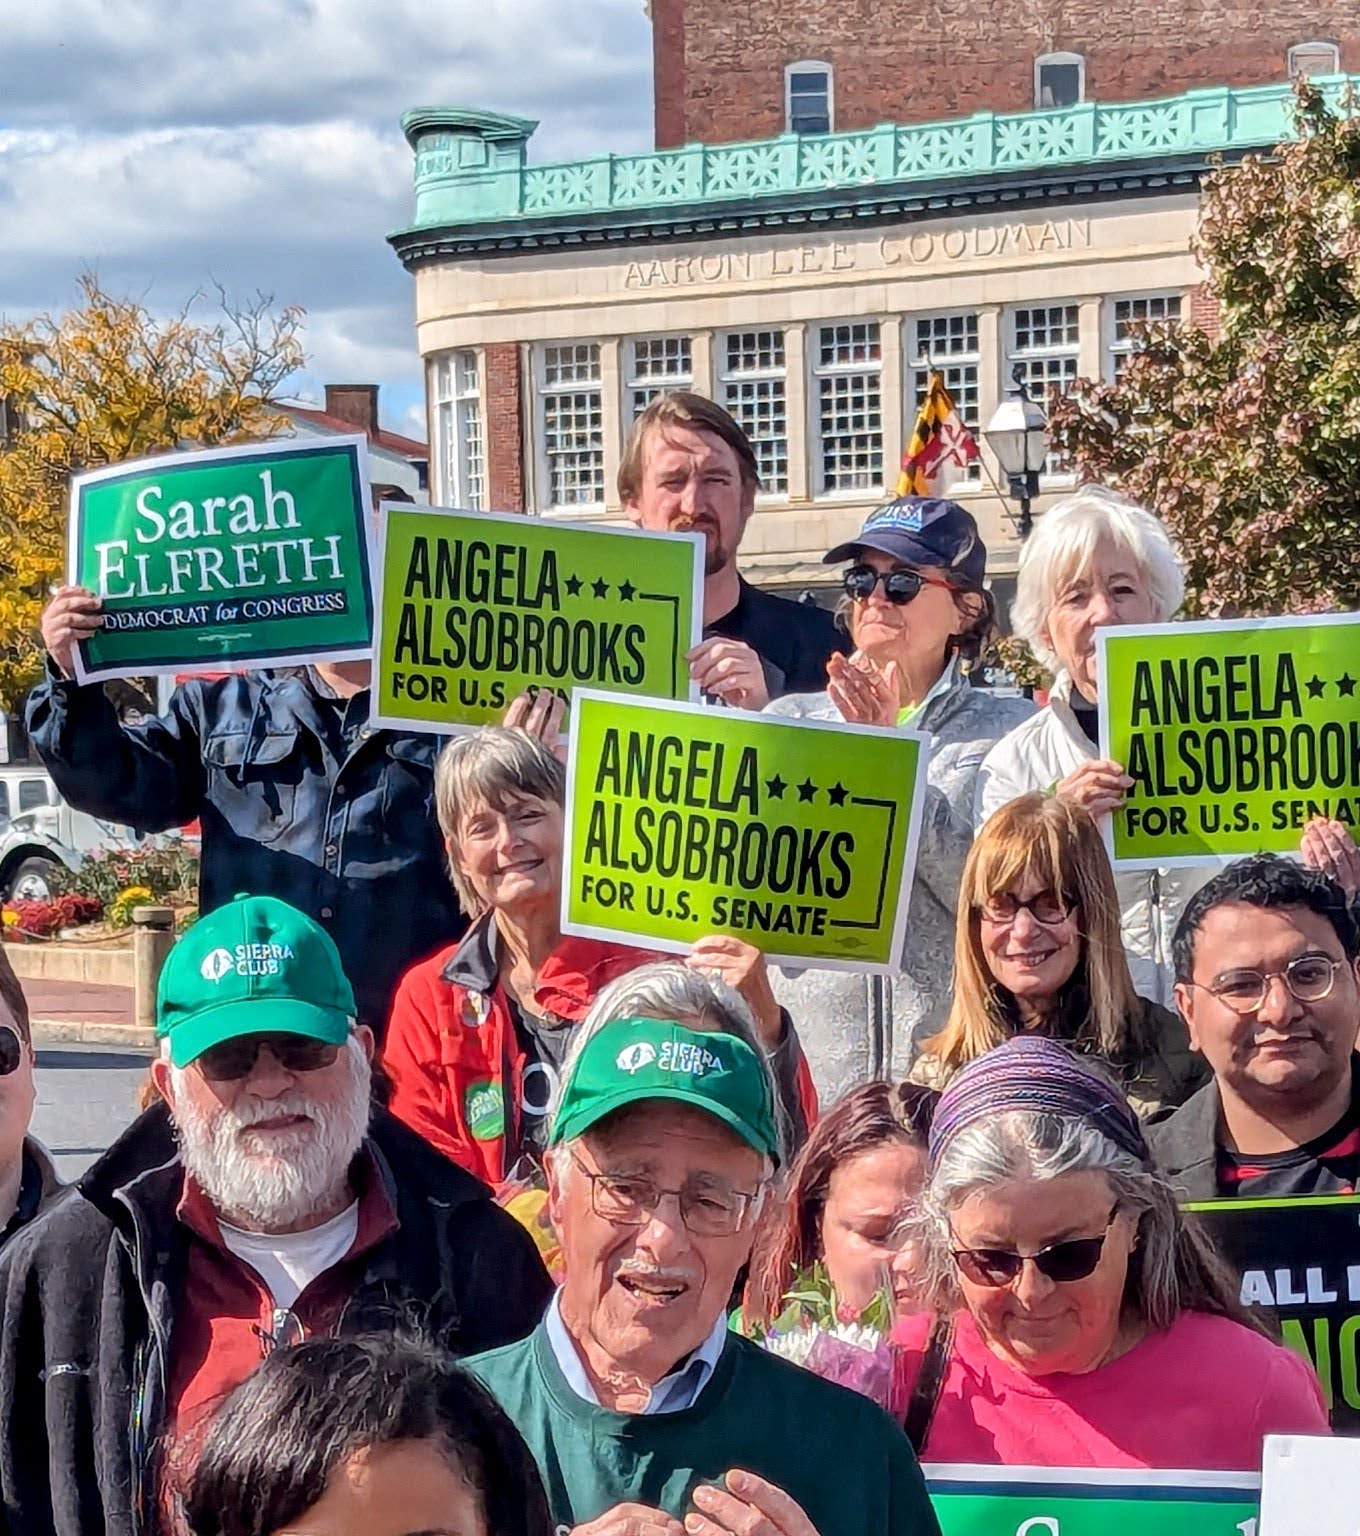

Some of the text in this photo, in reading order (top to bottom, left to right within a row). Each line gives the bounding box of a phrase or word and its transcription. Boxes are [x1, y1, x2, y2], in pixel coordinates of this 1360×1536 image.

[624, 252, 751, 289] AARON
[772, 239, 856, 275] LEE
[135, 469, 302, 543] Sarah
[94, 535, 344, 600] ELFRETH
[403, 536, 560, 611] ANGELA
[102, 594, 345, 629] DEMOCRAT for CONGRESS
[394, 603, 646, 685] ALSOBROOKS
[392, 672, 448, 703] FOR
[459, 678, 505, 709] U.S
[1130, 653, 1302, 727] ANGELA
[595, 728, 759, 815] ANGELA
[1126, 806, 1188, 837] FOR
[1200, 802, 1259, 833] U.S.
[584, 800, 855, 899] ALSOBROOKS
[581, 875, 829, 936] FOR U.S. SENATE
[235, 944, 294, 960] SIERRA
[236, 960, 279, 976] CLUB
[658, 1057, 704, 1075] CLUB
[660, 1041, 724, 1073] SIERRA
[1241, 1268, 1338, 1306] ALL
